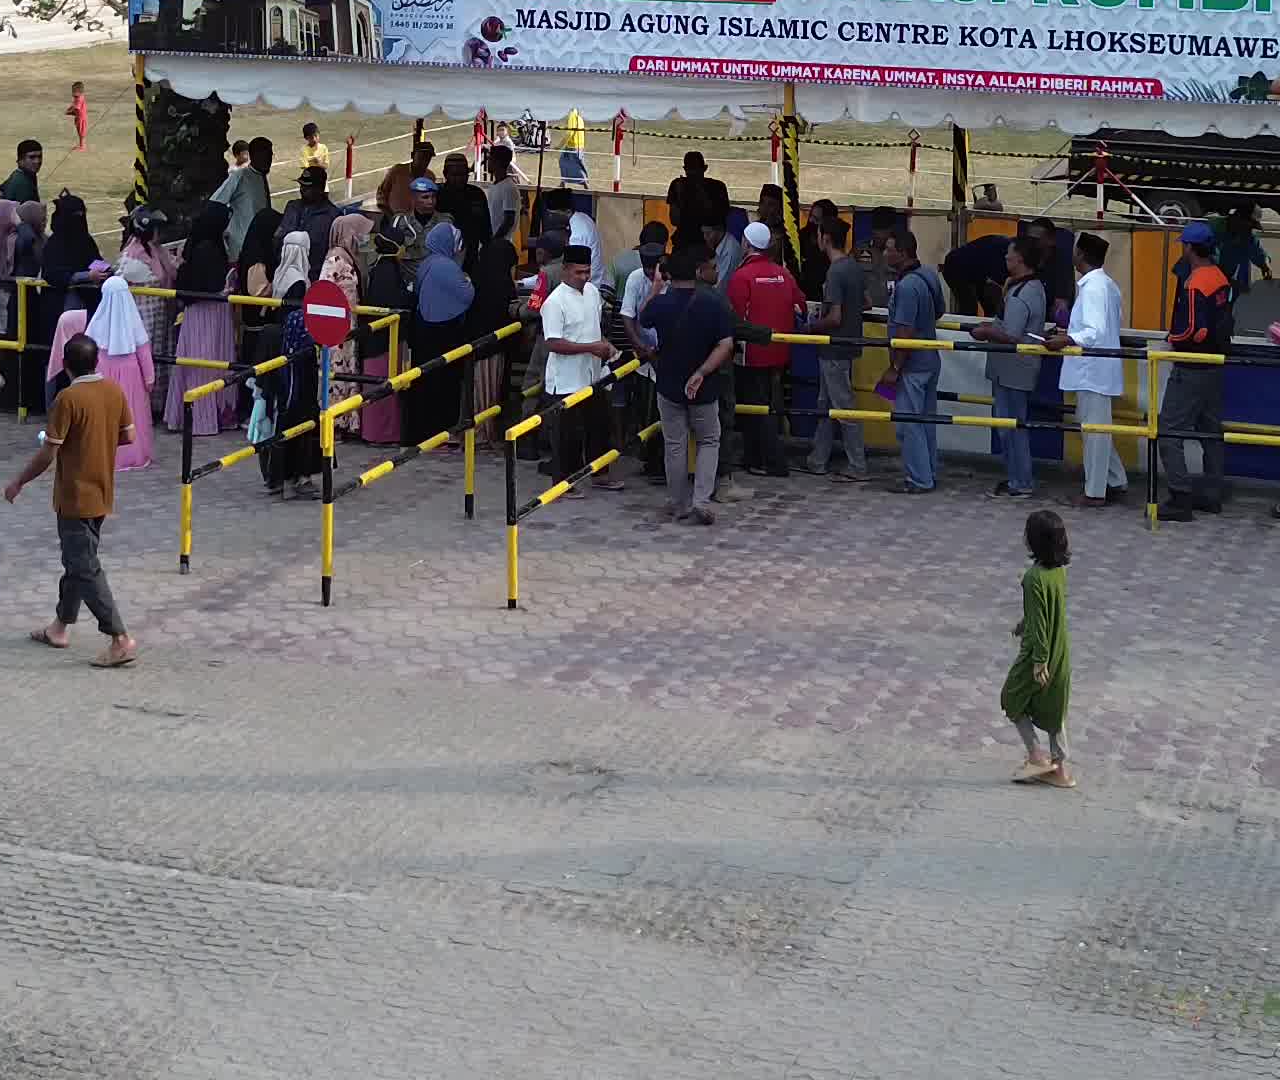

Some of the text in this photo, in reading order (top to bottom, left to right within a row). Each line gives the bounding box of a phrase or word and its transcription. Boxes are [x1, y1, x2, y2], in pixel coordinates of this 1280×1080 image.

[516, 9, 1279, 59] MASJID AGUNG ISLAMIC CENTRE KOTA LHOKSEUMAWE
[636, 59, 1155, 94] DARI UMMAT UNTUK UMMAT KARENA UMMAT, INSYA ALLAH DIBERI RAHMAT
